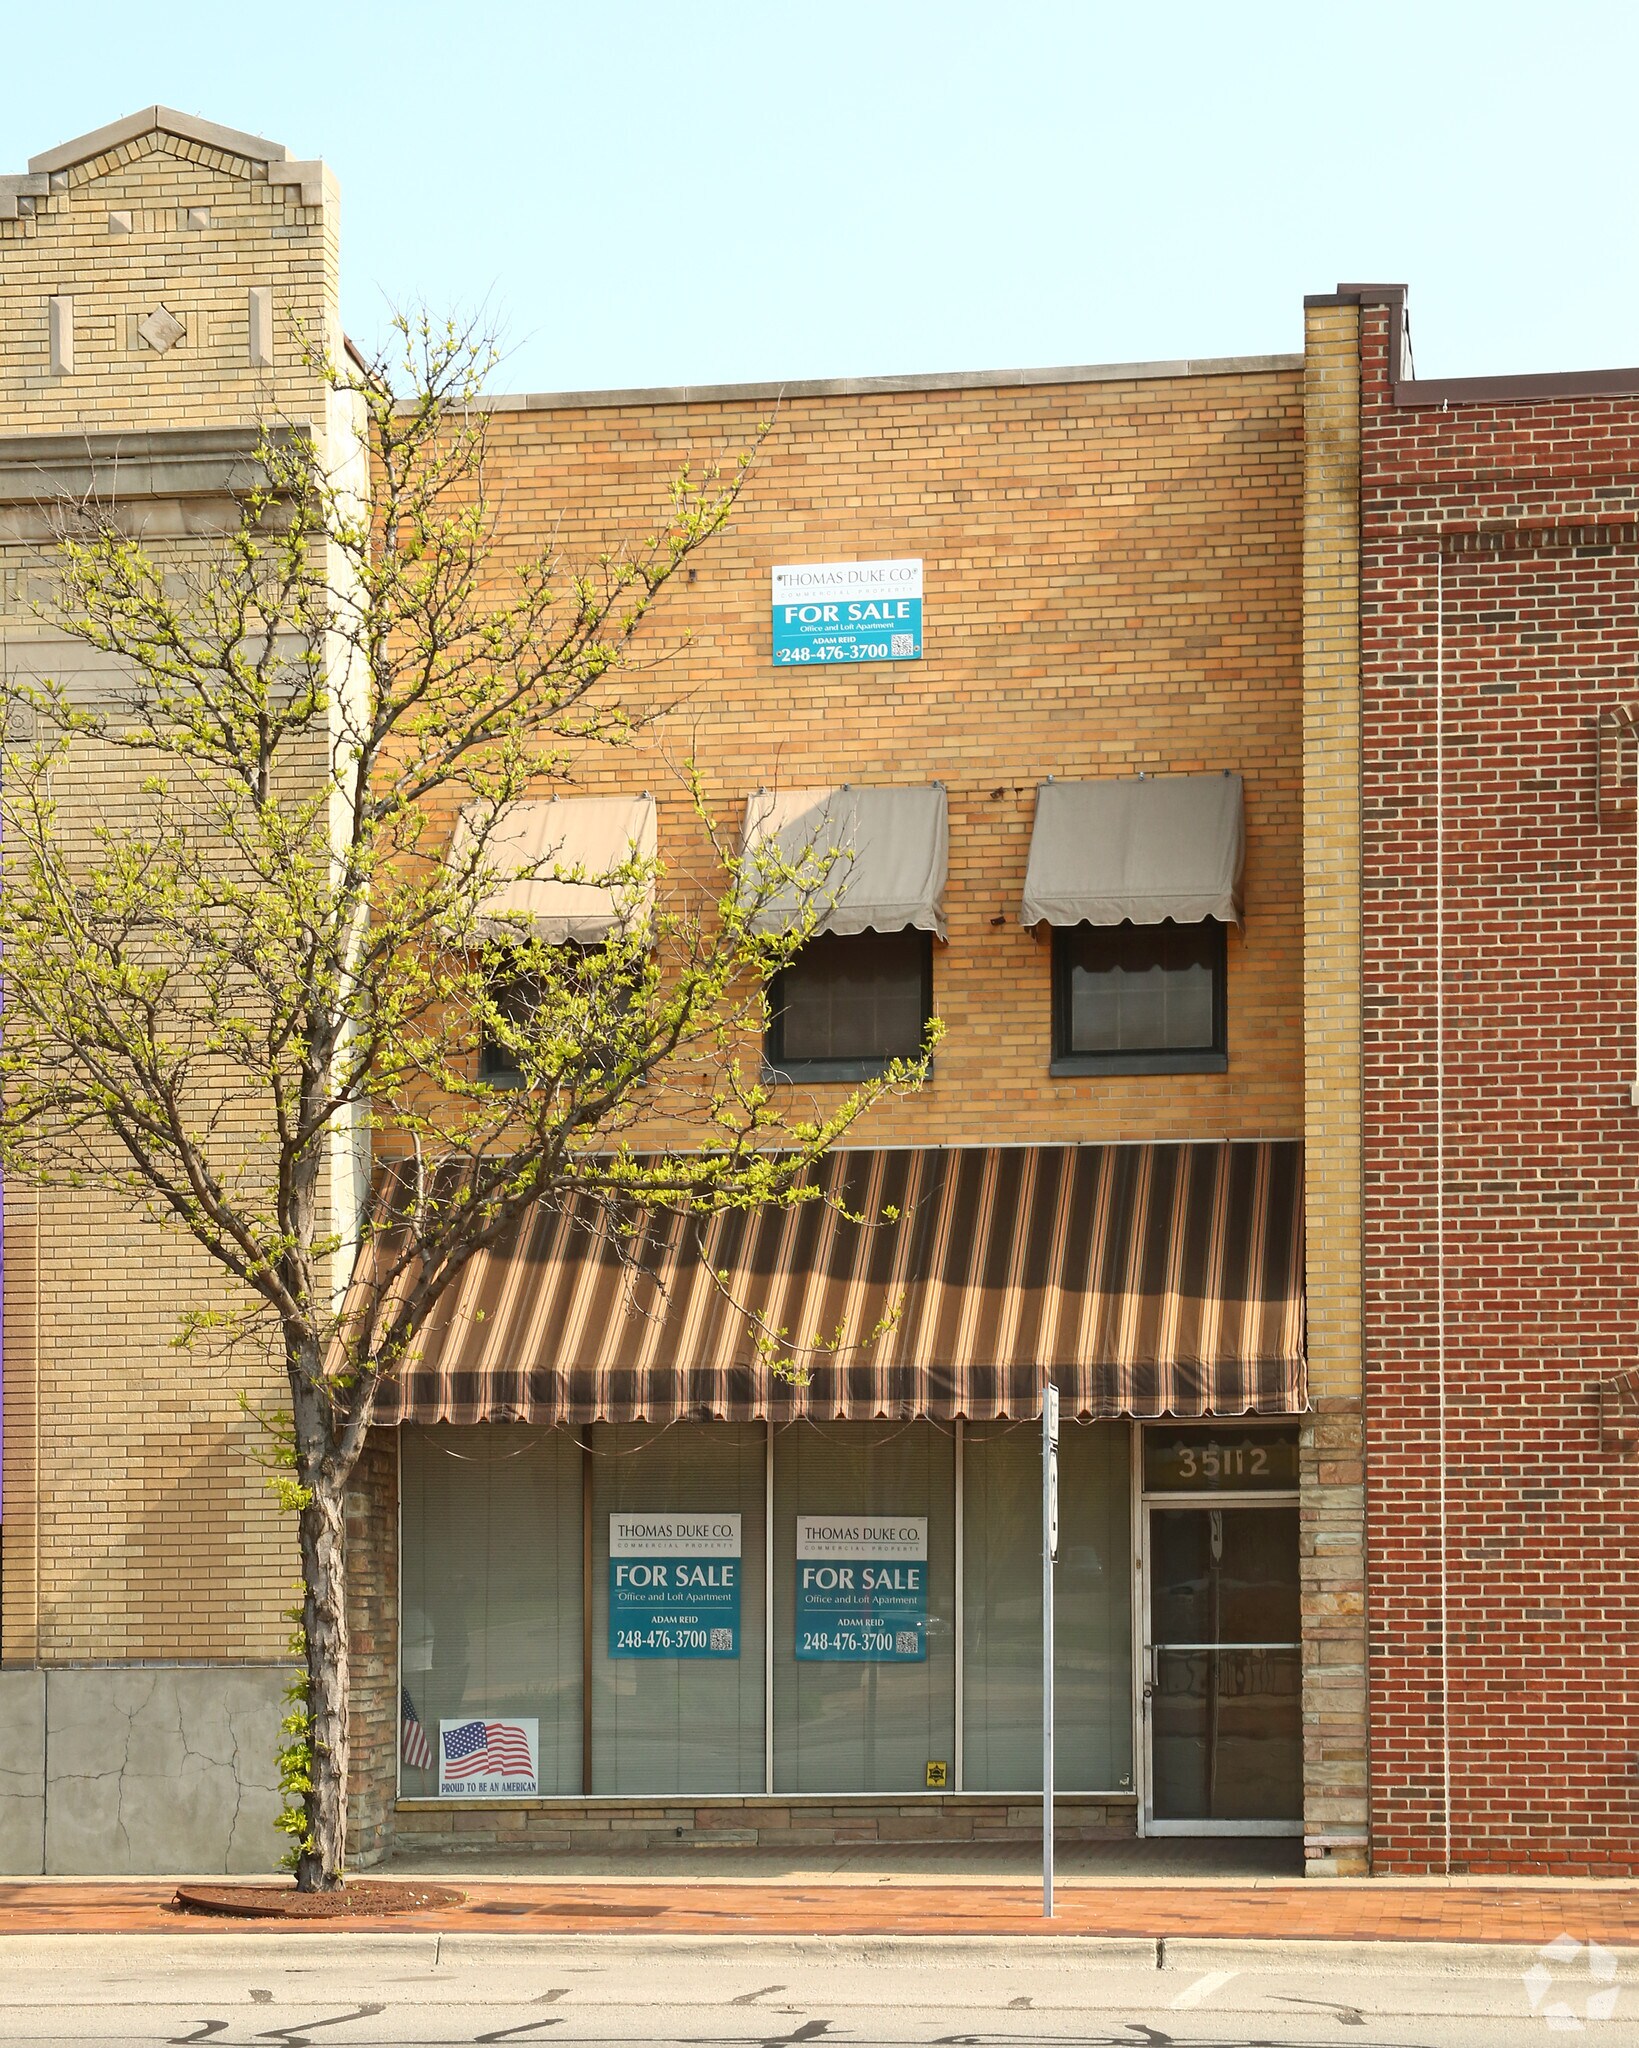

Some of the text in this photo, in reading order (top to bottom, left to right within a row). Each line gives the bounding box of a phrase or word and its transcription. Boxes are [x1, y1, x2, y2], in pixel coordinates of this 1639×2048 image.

[782, 568, 913, 586] THOMAS DUKE CO.
[781, 590, 850, 598] COMMERCIAL
[785, 601, 909, 623] FOR SALE
[856, 622, 894, 631] Apartment
[781, 644, 888, 661] 248-476-3700
[1179, 1448, 1270, 1478] 35112
[618, 1525, 733, 1537] THOMAS DUKE CO.
[805, 1527, 919, 1540] THOMAS DUKE CO.
[617, 1566, 733, 1586] FOR SALE
[803, 1568, 919, 1589] FOR SALE
[619, 1593, 731, 1603] Office and Loft Apartment
[805, 1595, 917, 1606] Office and Loft Apartment
[617, 1630, 707, 1648] 248-476-3700
[804, 1633, 892, 1650] 248-476-3700
[442, 1782, 536, 1792] PROUD TO BE AN AMERICAN
